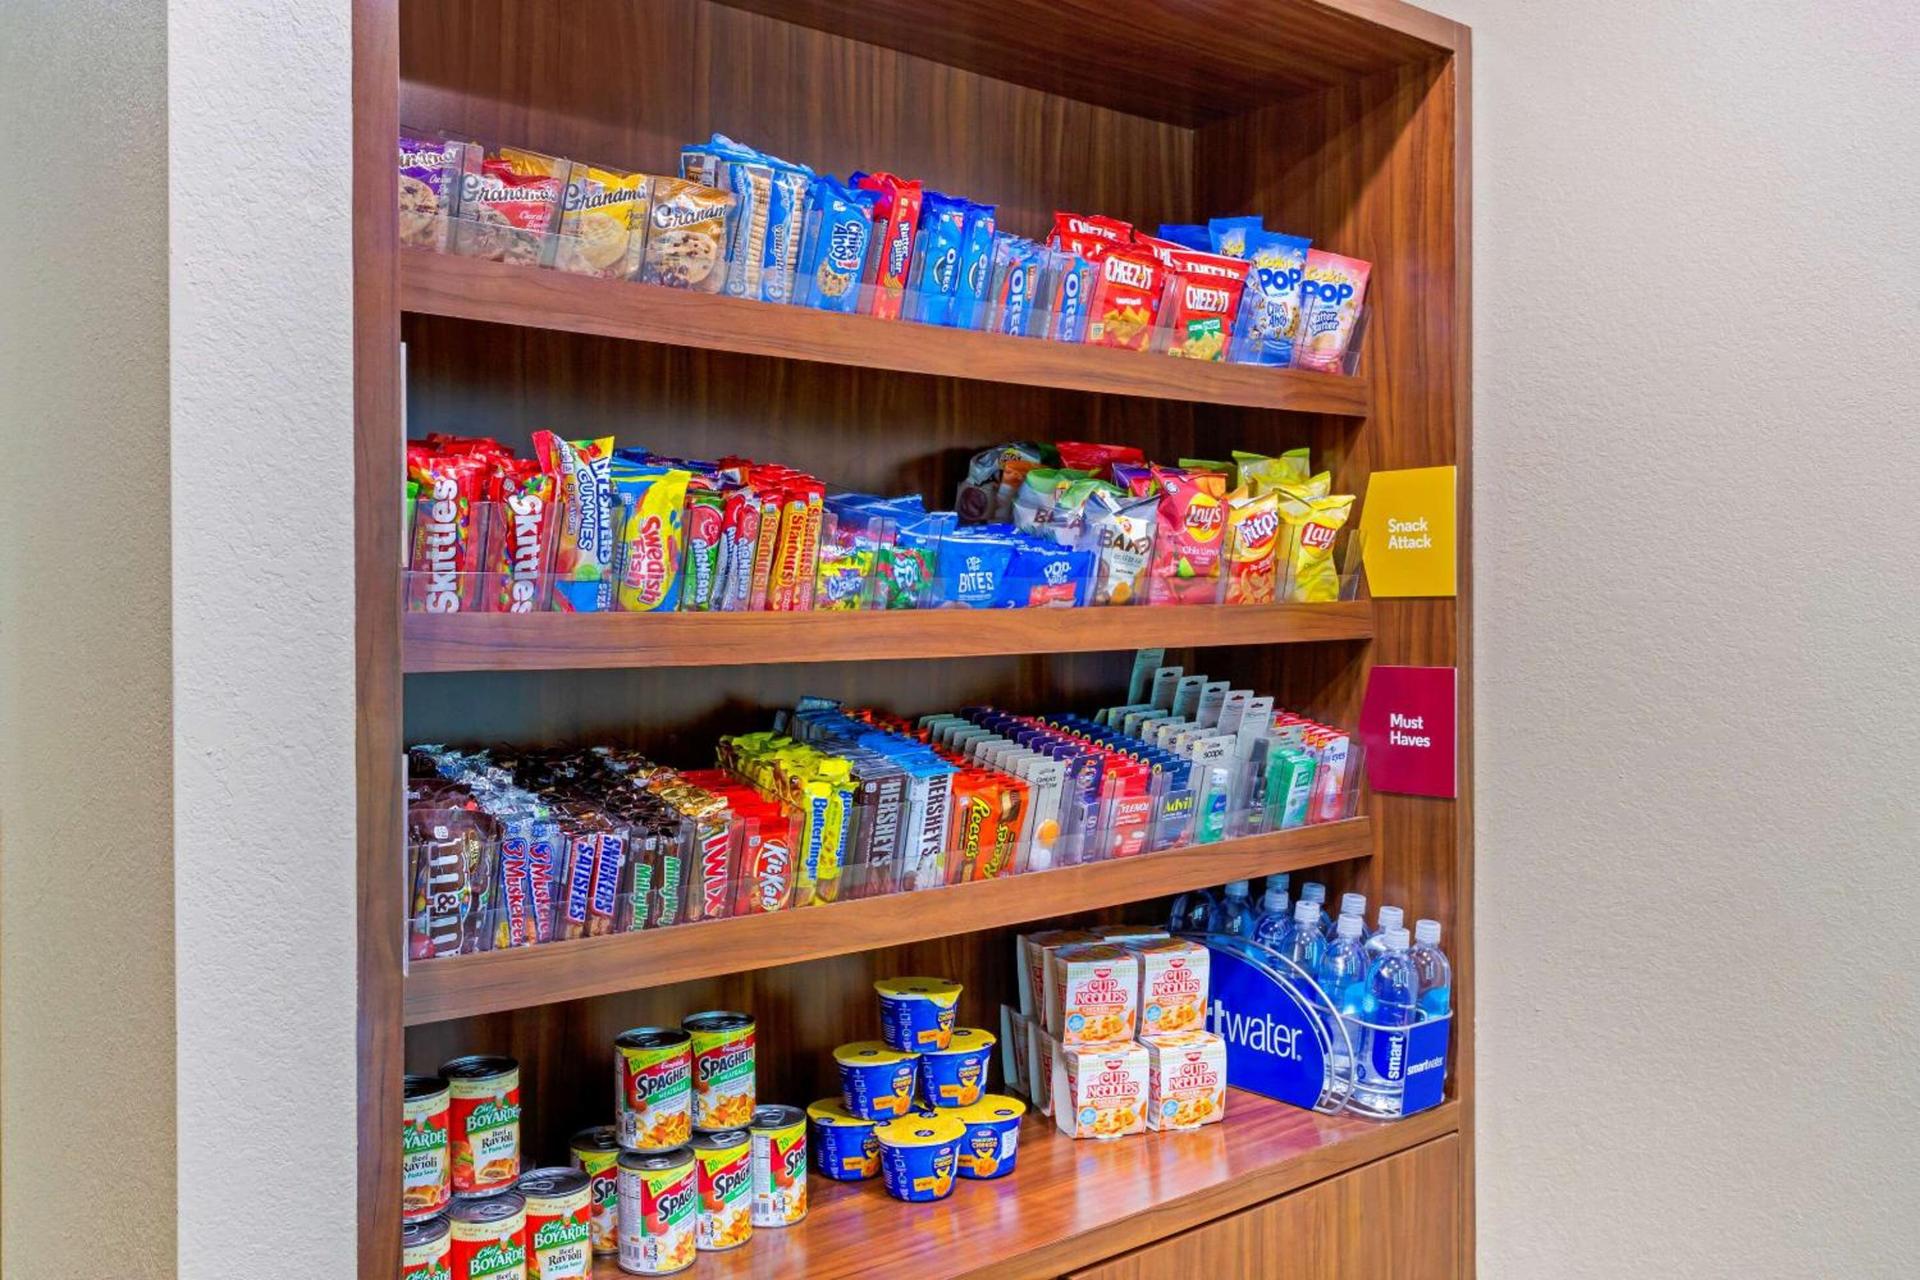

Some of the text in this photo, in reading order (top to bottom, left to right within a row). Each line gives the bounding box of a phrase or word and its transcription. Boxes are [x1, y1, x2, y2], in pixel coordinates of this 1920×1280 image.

[1258, 268, 1302, 297] POP
[1301, 280, 1354, 308] POP
[577, 469, 596, 551] GUMMIES
[1388, 517, 1428, 533] Snack
[426, 479, 459, 613] Skittles
[1388, 534, 1432, 549] Attack
[508, 494, 543, 613] Skittles
[624, 538, 645, 588] Fish
[639, 515, 665, 603] Swedish
[958, 572, 994, 593] BITES
[1390, 713, 1424, 729] Must
[1390, 731, 1431, 747] Haves
[922, 774, 948, 856] HERSHEY'S
[1164, 797, 1193, 813] Advil
[806, 797, 828, 881] Butterfinger
[1088, 979, 1118, 993] CUP
[1164, 969, 1192, 982] CUP
[1388, 1035, 1404, 1080] smart
[1407, 1056, 1444, 1076] smartwater
[1099, 1072, 1129, 1086] CUP
[1180, 1062, 1208, 1077] CUP
[403, 1128, 447, 1149] YARDEE
